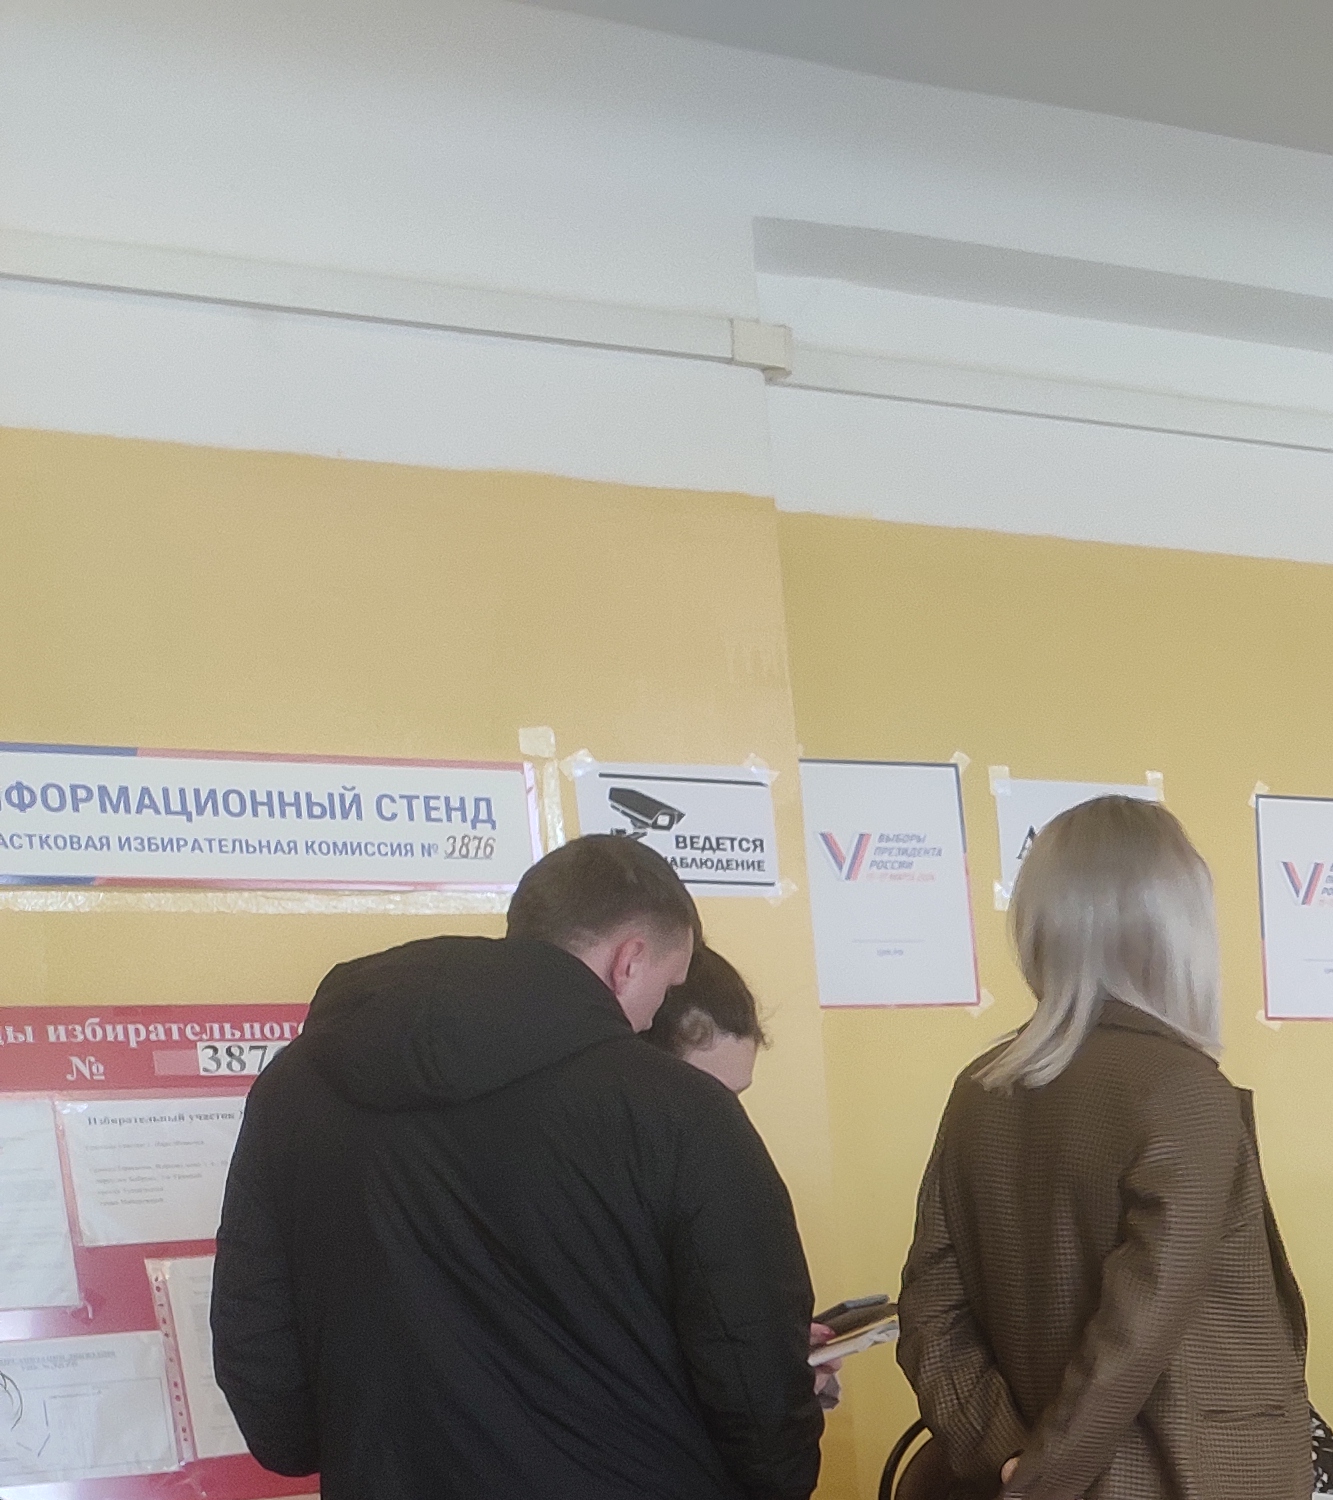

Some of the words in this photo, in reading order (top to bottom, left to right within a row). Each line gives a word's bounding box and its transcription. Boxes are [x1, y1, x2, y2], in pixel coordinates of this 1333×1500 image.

[0, 780, 363, 823] ФОРМАЦИОННЫЙ
[376, 793, 497, 831] СТЕНД
[118, 835, 298, 856] ИЗБИРАТЕЛЬНАЯ
[305, 840, 414, 858] КОМИССИЯ
[445, 834, 496, 859] 3876
[675, 835, 764, 853] ВЕДЕТСЯ
[878, 833, 926, 843] ВЫБОРЫ
[874, 847, 942, 857] ПРЕЗИДЕНТА
[869, 860, 914, 870] РОССИИ
[66, 1056, 105, 1080] №
